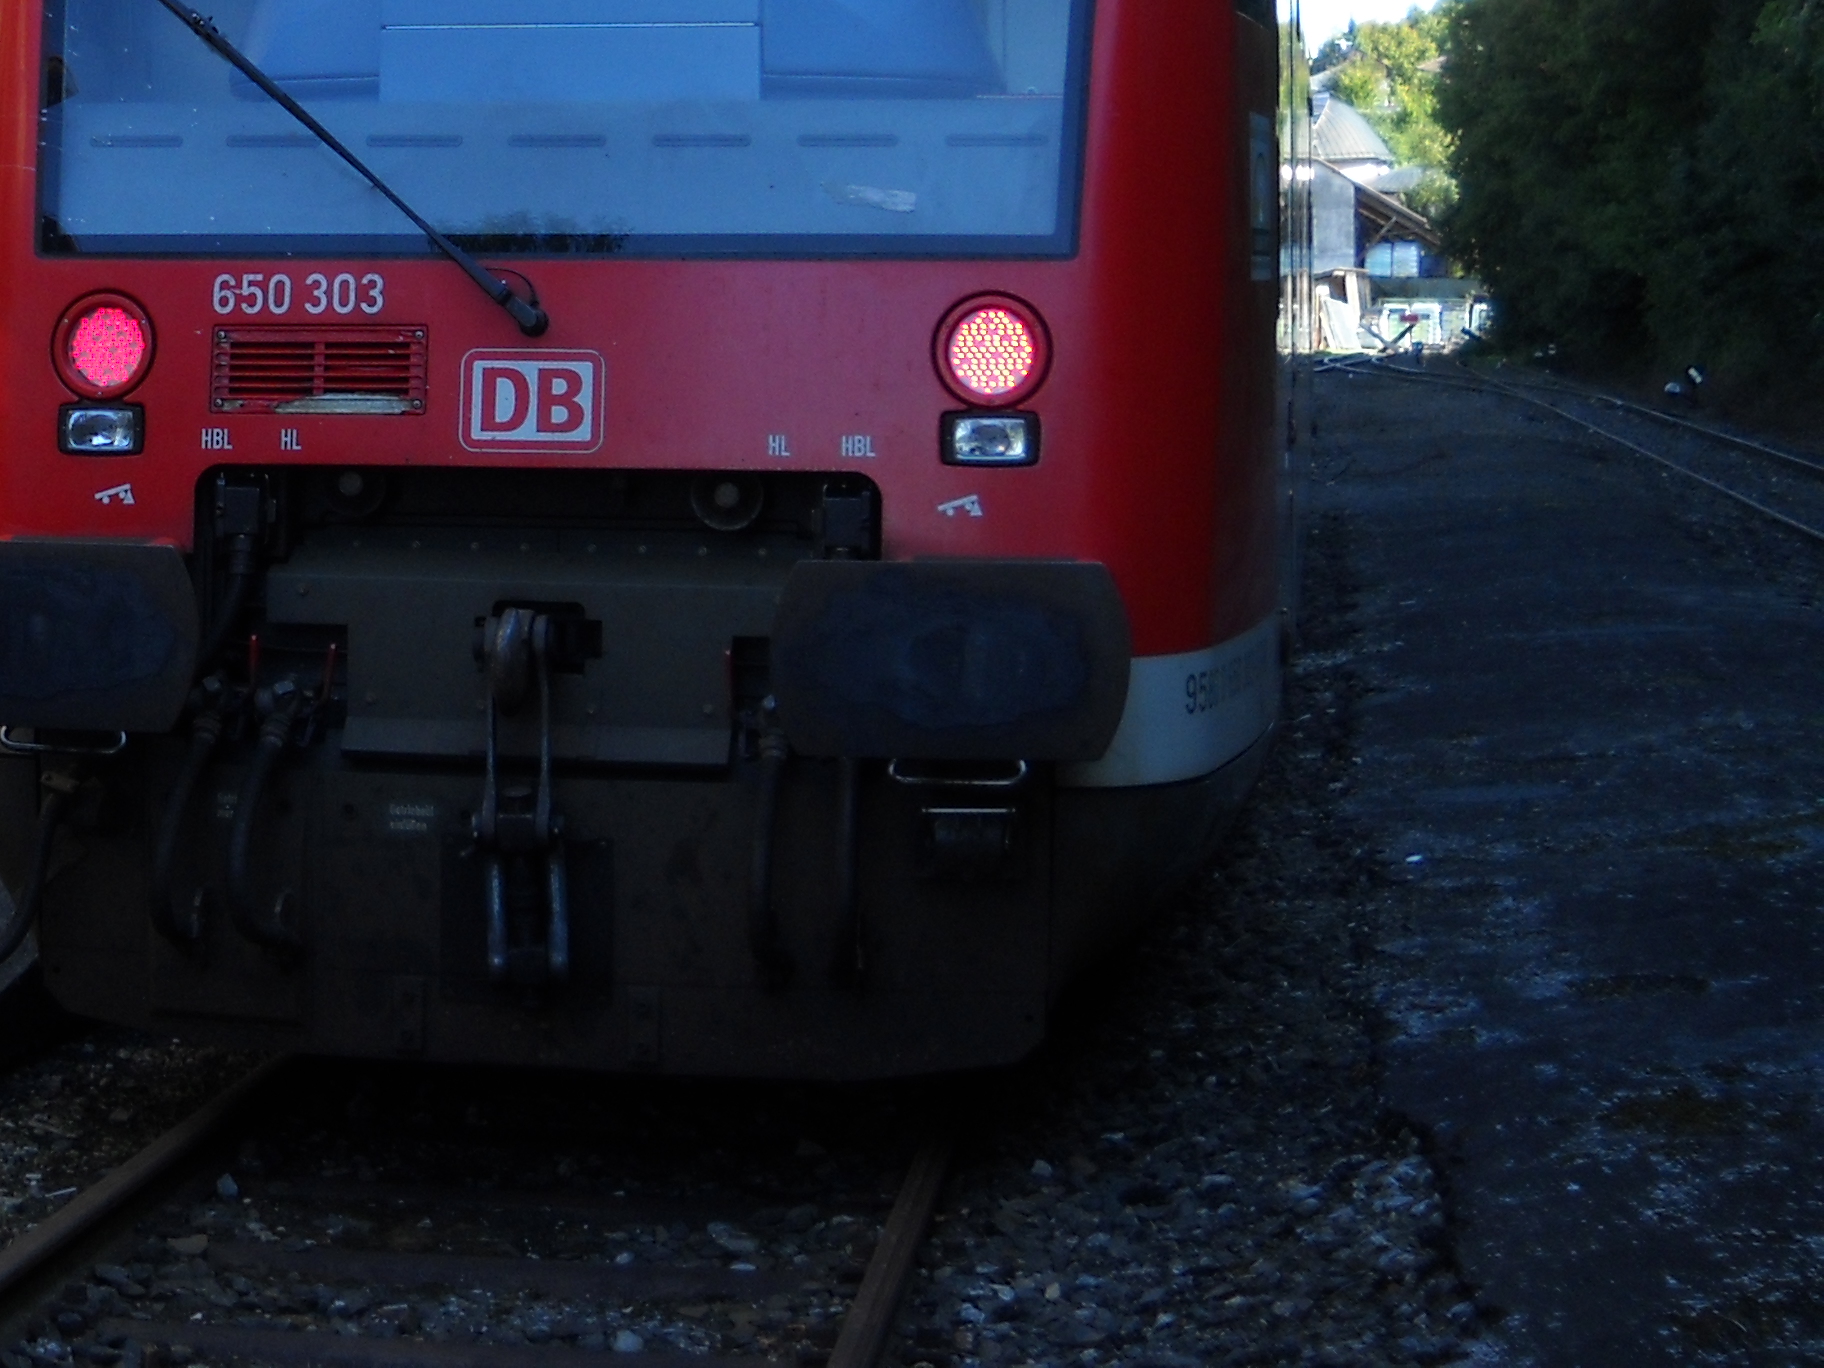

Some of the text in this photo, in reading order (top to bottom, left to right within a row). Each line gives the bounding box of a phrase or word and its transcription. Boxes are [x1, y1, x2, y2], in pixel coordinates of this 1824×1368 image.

[212, 273, 386, 315] 650 303
[478, 365, 587, 435] DB
[200, 428, 233, 451] HBL
[280, 428, 302, 451] HL
[767, 434, 791, 457] HL
[840, 434, 876, 458] HBL
